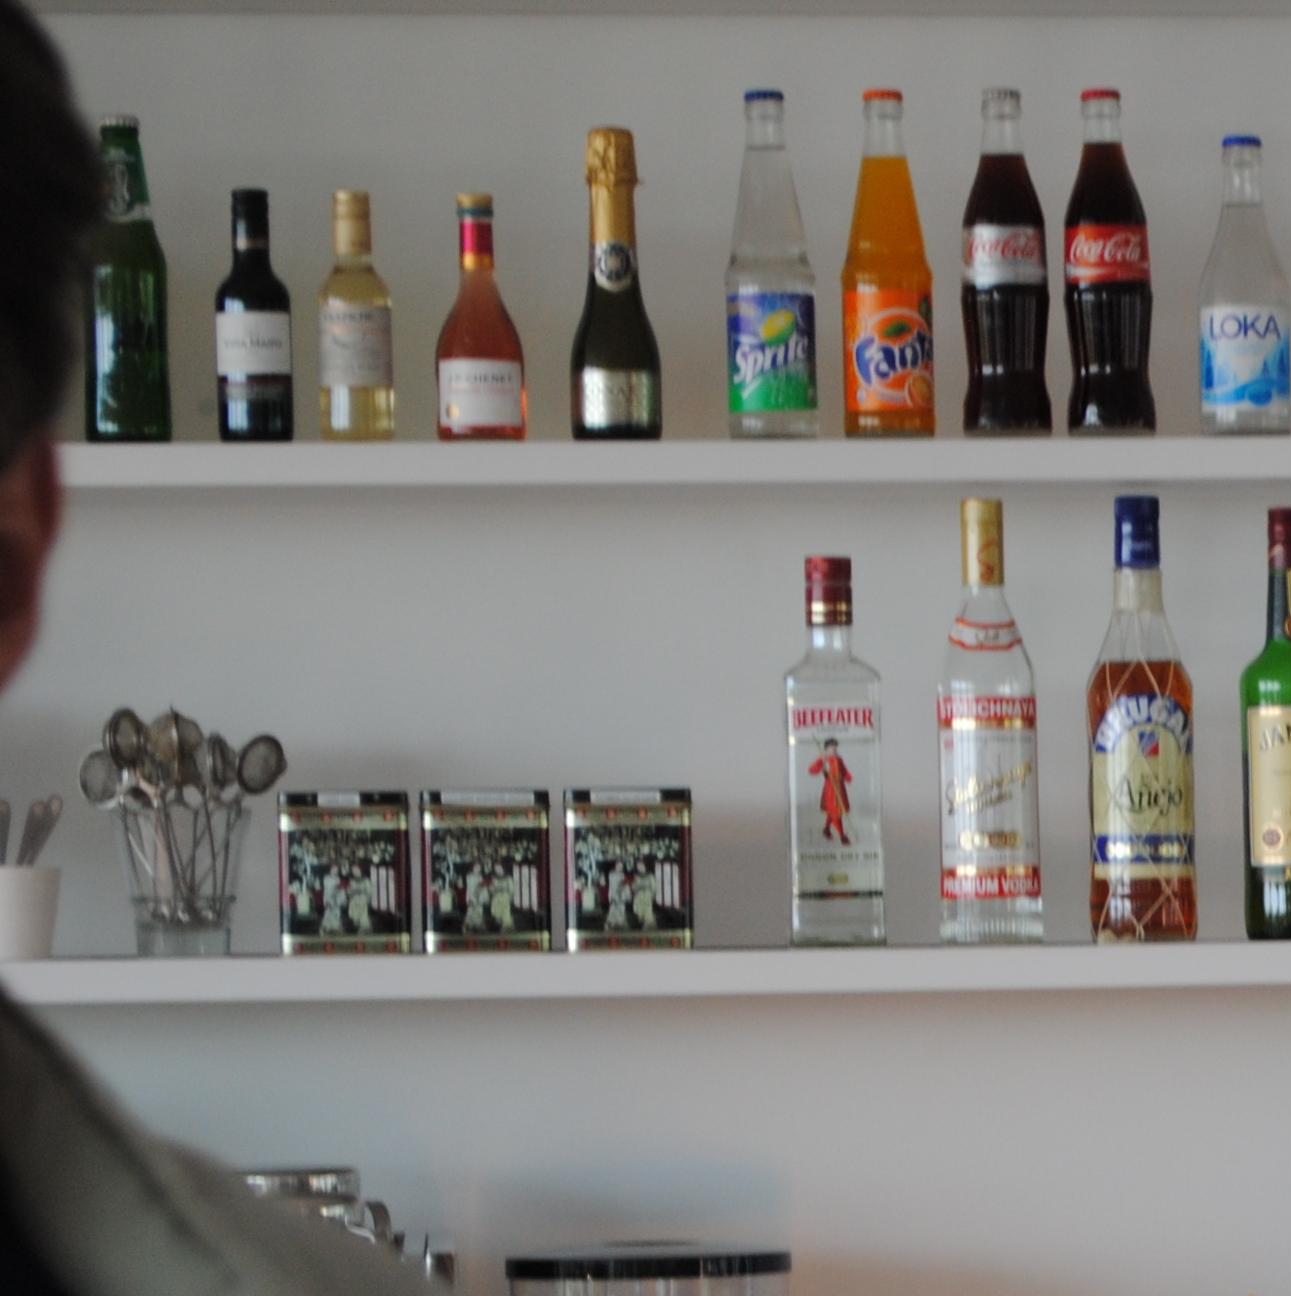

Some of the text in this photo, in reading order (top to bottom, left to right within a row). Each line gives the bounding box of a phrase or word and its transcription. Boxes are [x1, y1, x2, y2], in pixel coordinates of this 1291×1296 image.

[1209, 313, 1282, 340] LOKA
[733, 332, 809, 386] Sprite
[793, 707, 875, 730] BEEFEATER
[1001, 875, 1039, 896] VODKA
